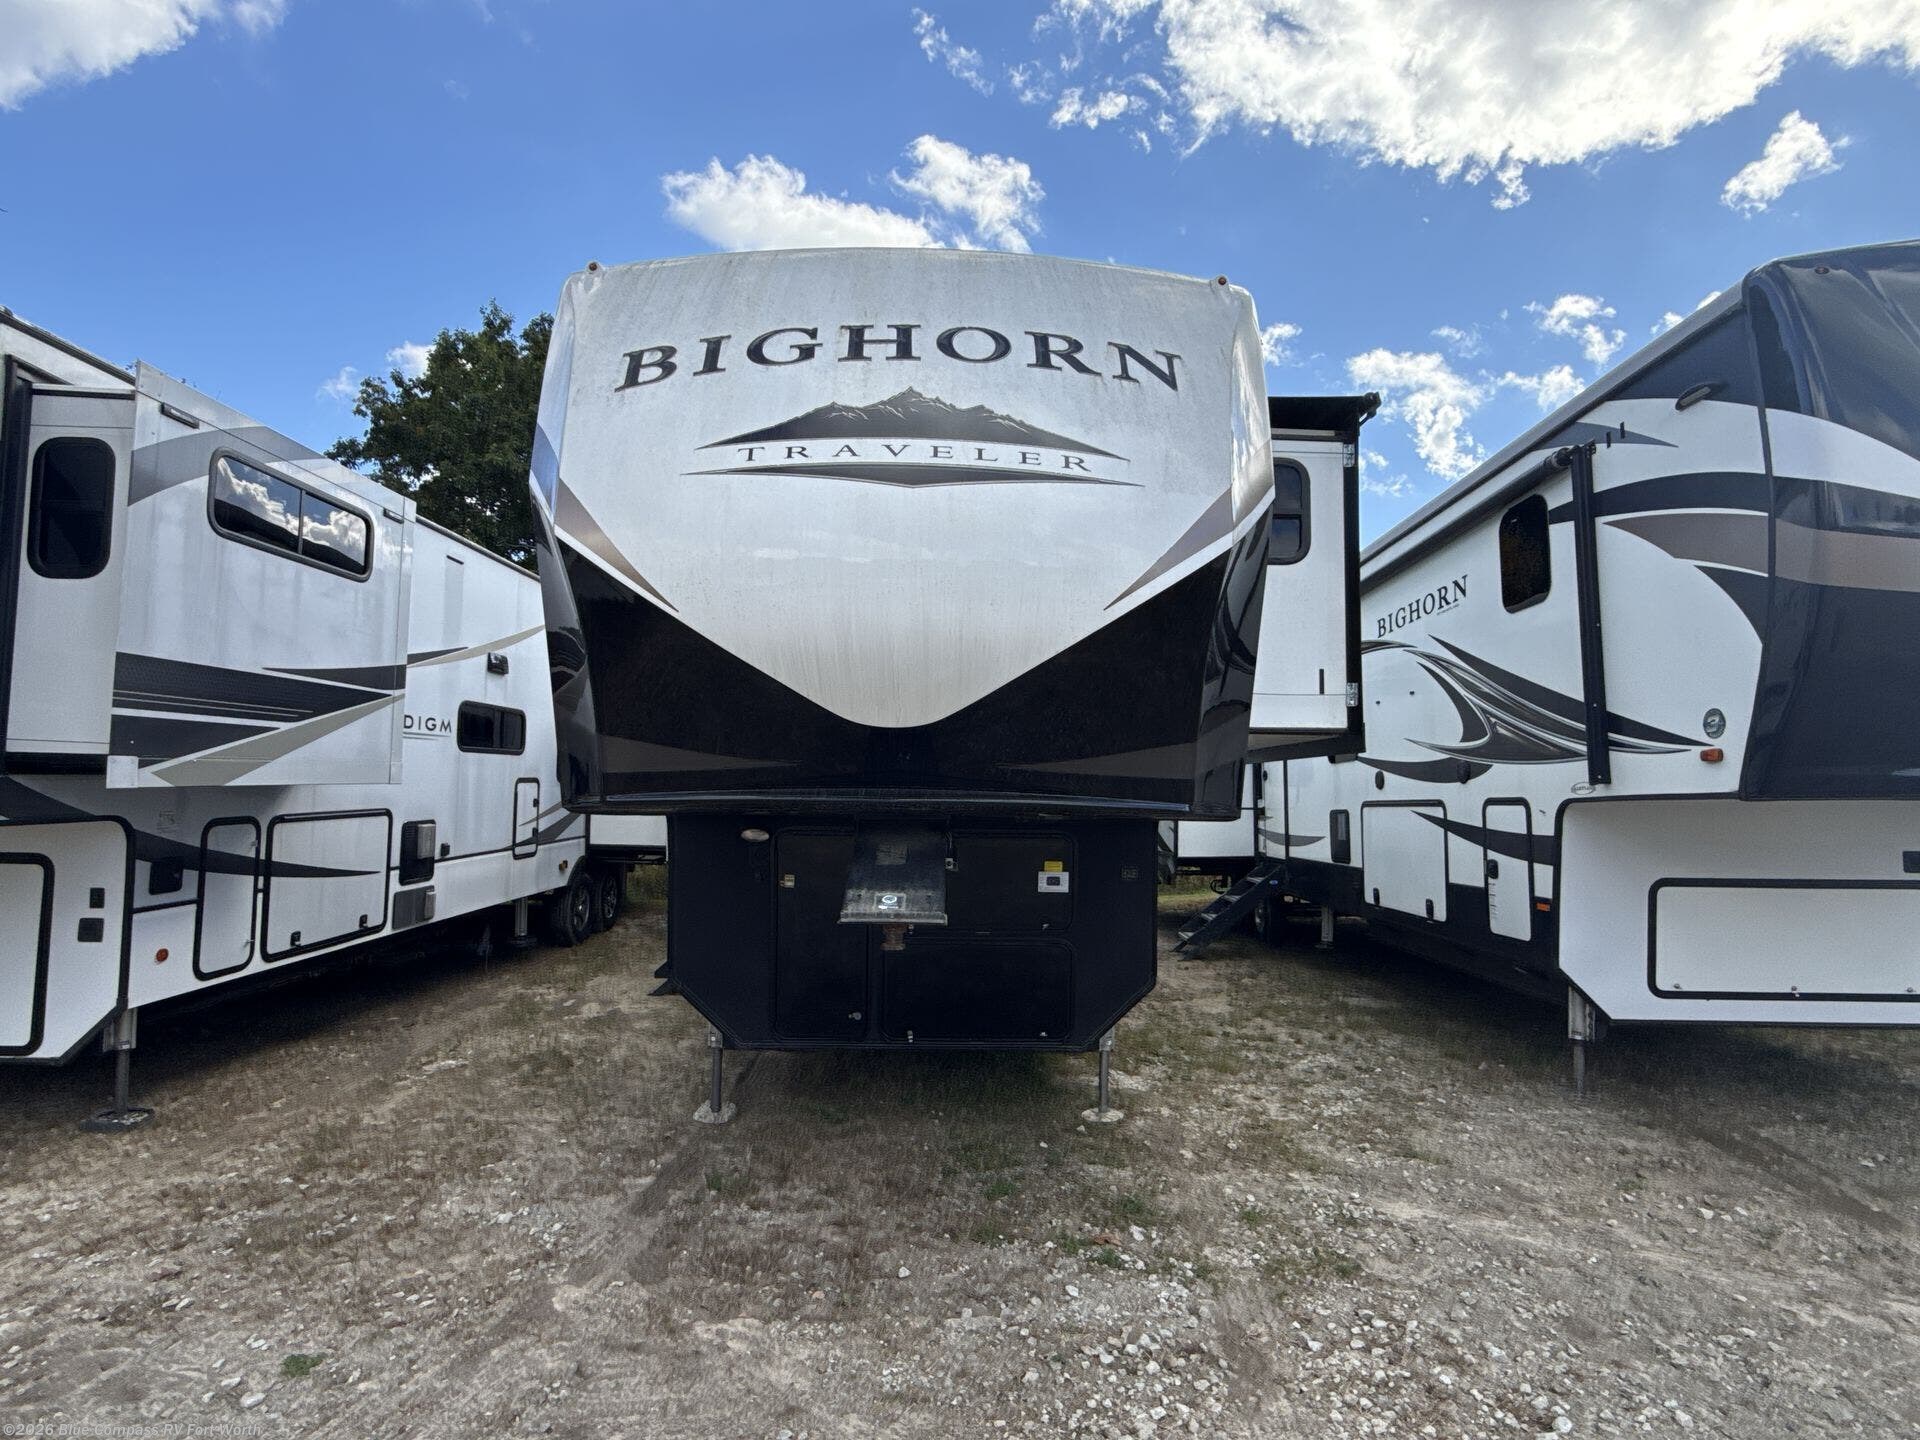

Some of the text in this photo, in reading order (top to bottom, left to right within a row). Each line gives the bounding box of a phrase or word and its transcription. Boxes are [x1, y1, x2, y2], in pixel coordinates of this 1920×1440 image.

[614, 324, 1182, 393] BIGHORN
[738, 444, 1092, 473] TRAVELER
[1376, 574, 1468, 639] BIGHORN
